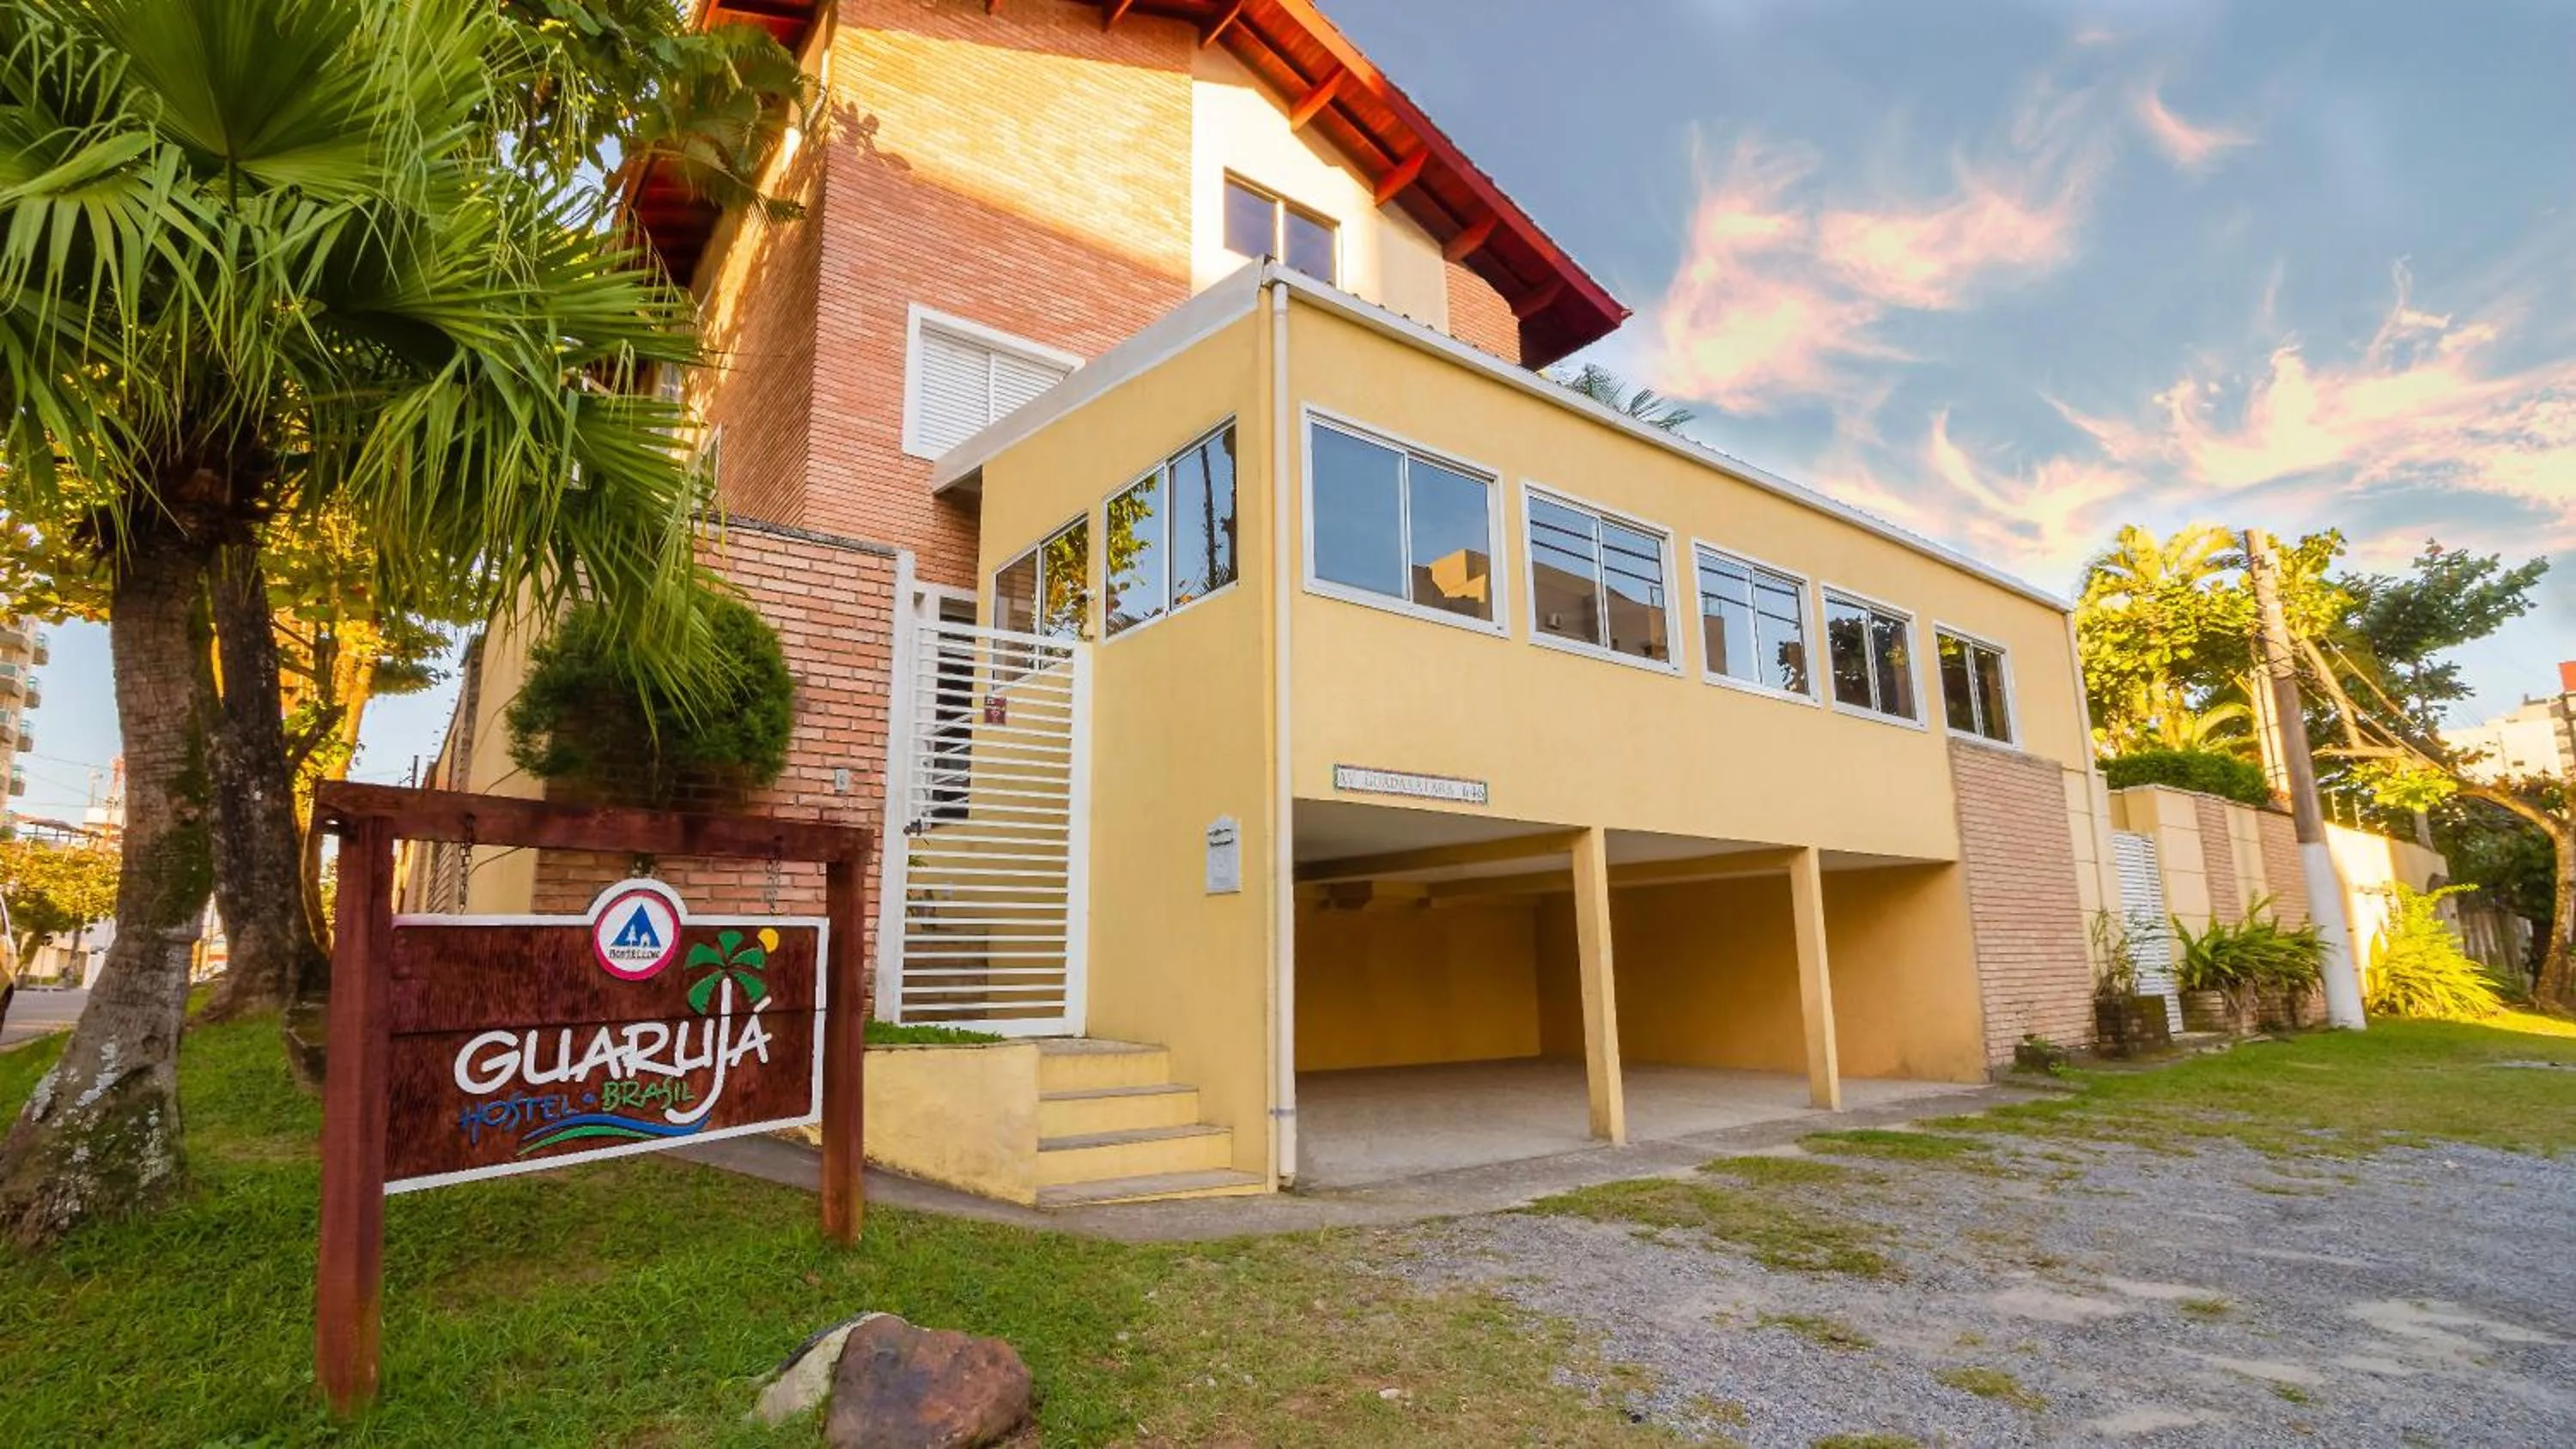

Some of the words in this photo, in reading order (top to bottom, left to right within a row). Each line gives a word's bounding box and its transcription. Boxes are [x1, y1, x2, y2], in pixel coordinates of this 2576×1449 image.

[453, 978, 773, 1124] GUARUJÁ
[459, 1091, 580, 1146] HOSTEL
[602, 1075, 695, 1113] BRASIL
